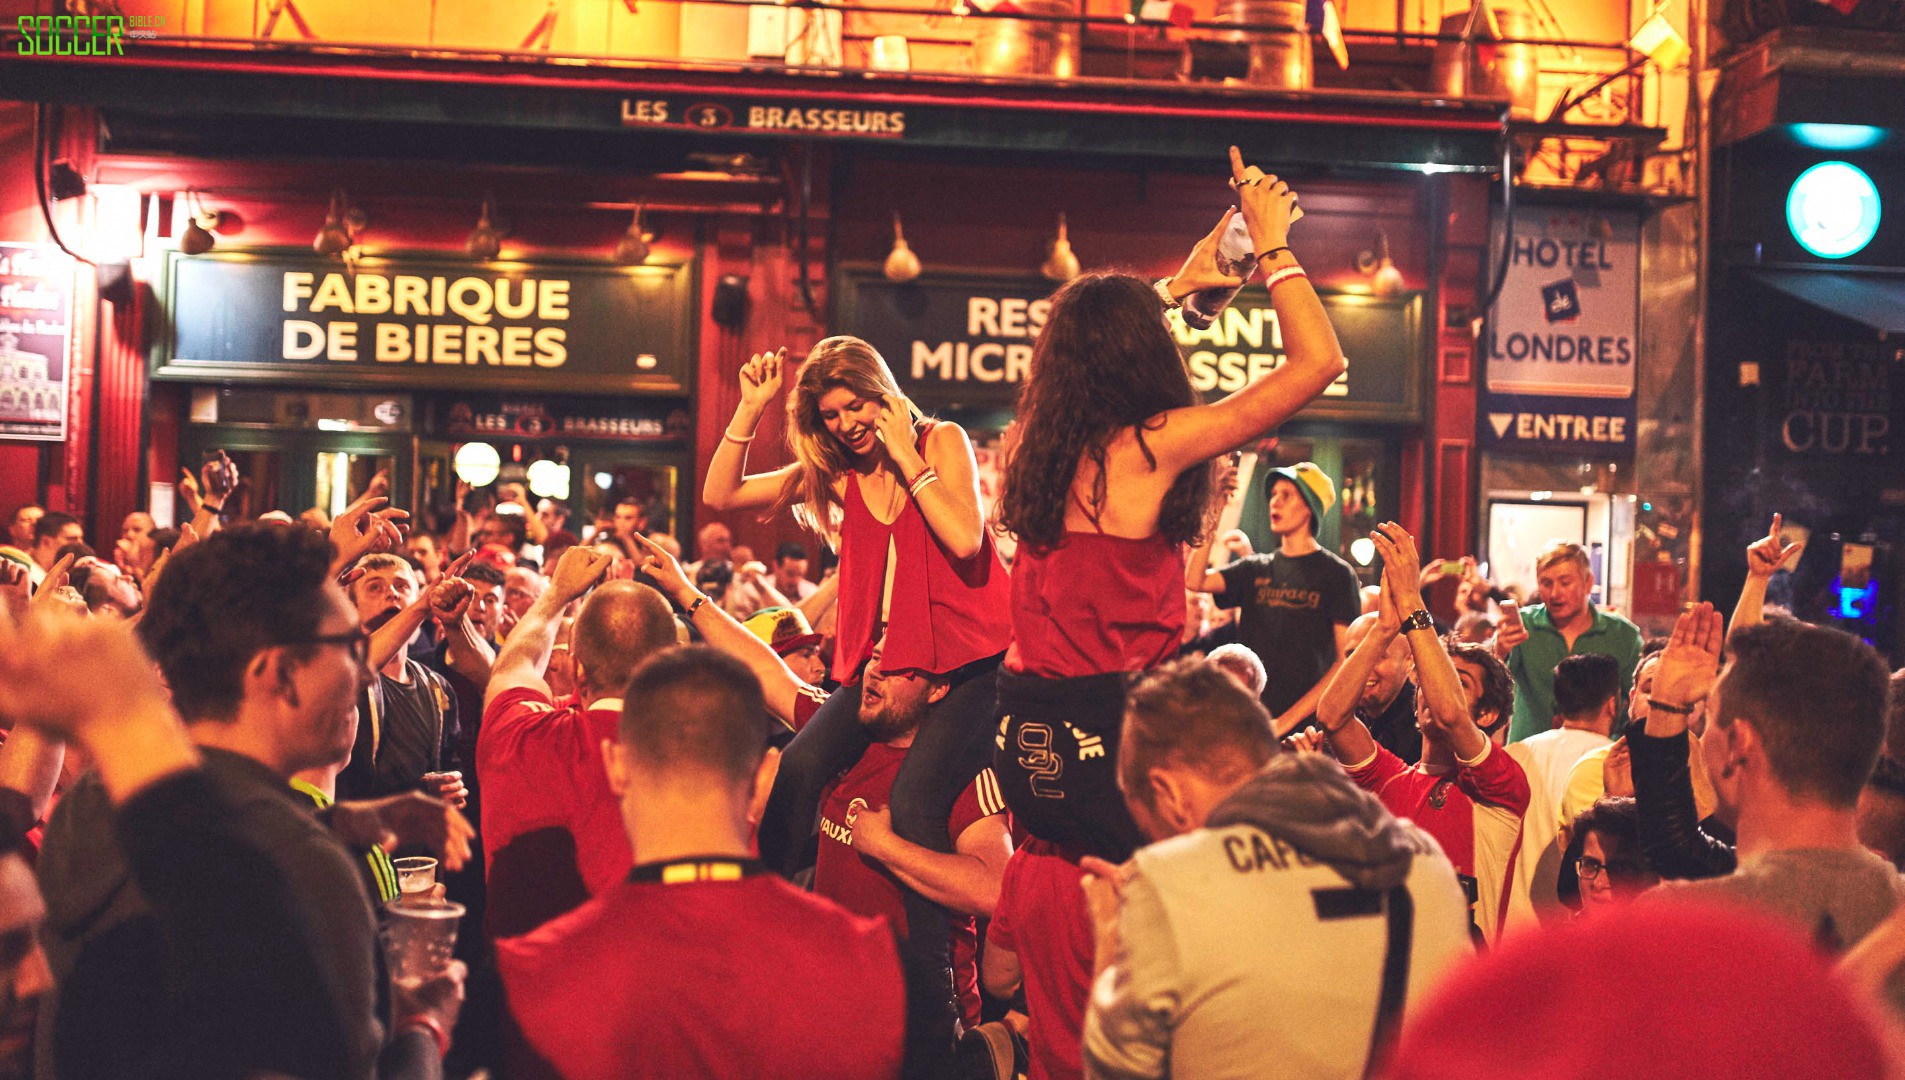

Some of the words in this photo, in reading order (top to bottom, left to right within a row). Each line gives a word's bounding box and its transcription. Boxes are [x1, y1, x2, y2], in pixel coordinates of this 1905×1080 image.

[621, 99, 668, 122] LES
[701, 108, 717, 127] 3
[749, 106, 905, 133] BRASSEURS
[1513, 238, 1612, 271] HOTEL
[282, 271, 571, 325] FABRIQUE
[282, 319, 359, 361] DE
[375, 322, 568, 368] BIERES
[1490, 332, 1631, 365] LONDRES
[476, 414, 507, 430] LES
[564, 417, 664, 436] BRASSEURS
[1516, 413, 1627, 443] ENTREE
